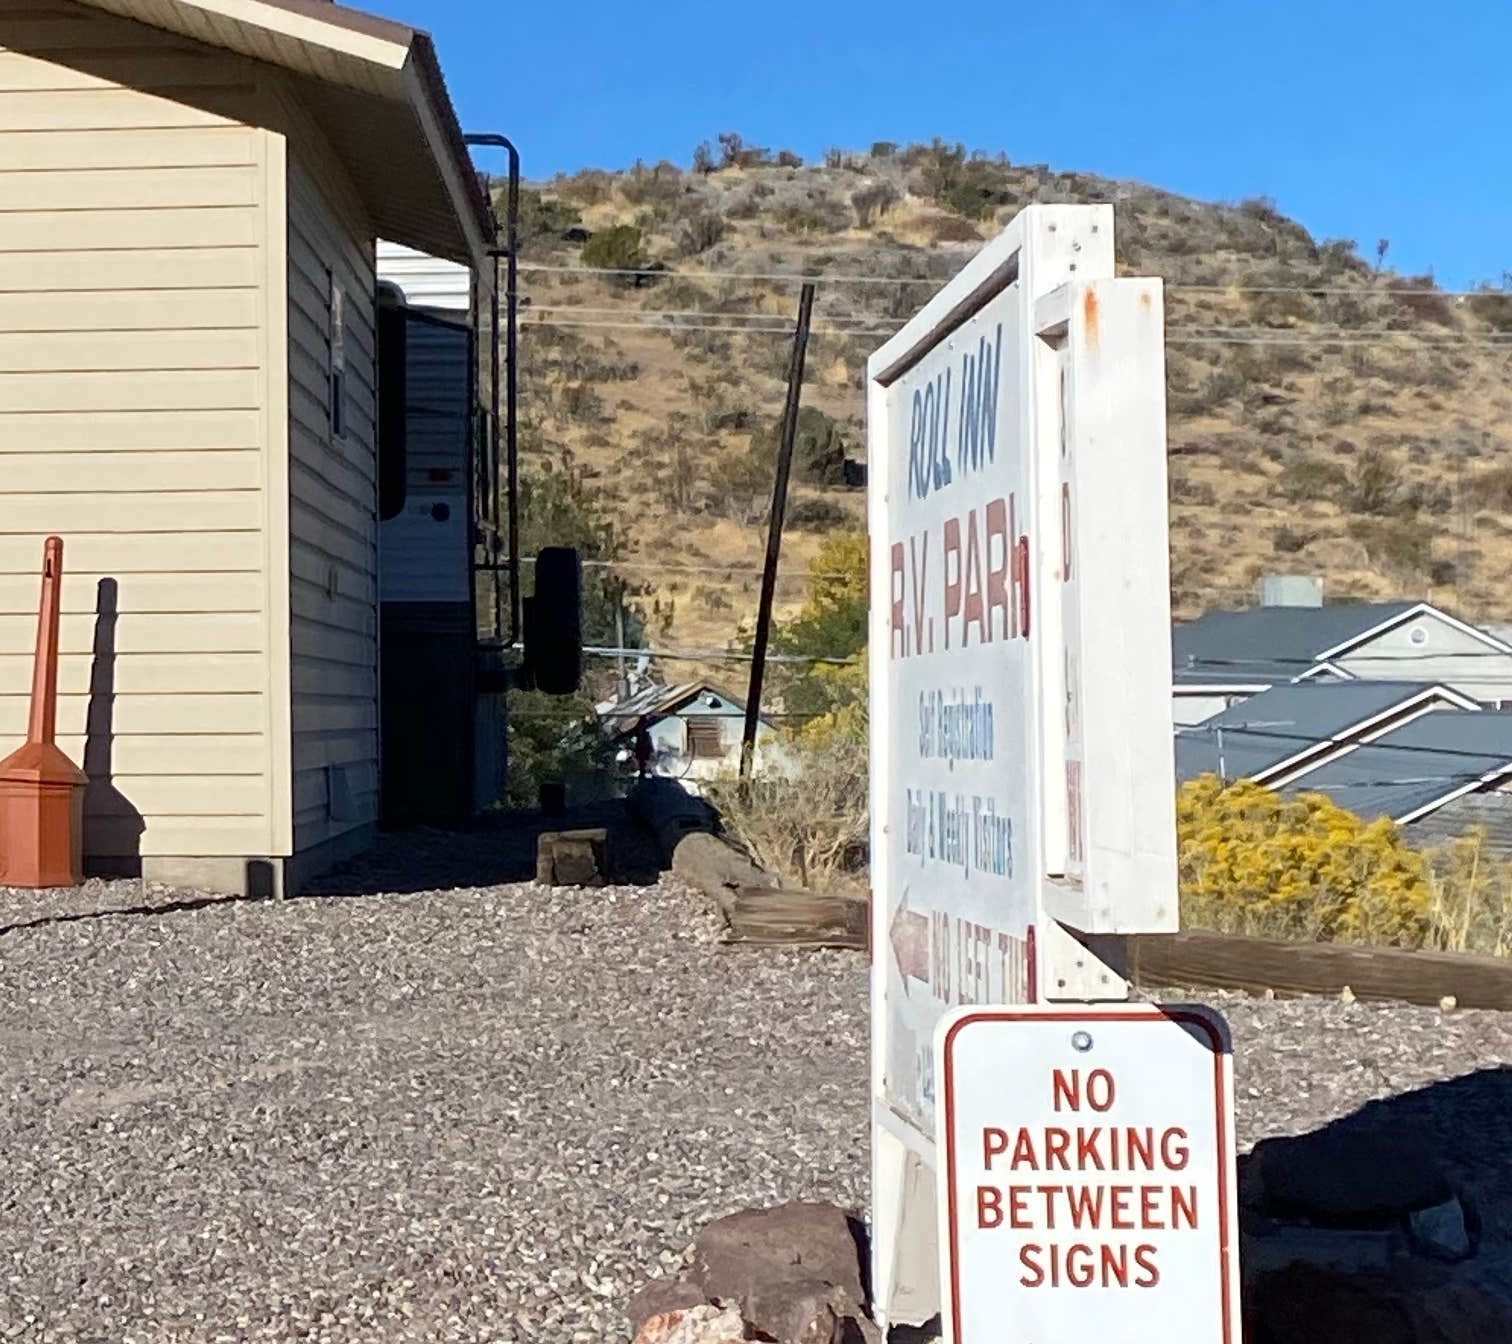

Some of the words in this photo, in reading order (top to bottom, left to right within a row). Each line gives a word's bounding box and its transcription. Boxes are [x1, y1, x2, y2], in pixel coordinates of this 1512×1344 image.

[908, 366, 952, 502] ROLL
[958, 323, 1003, 476] INN
[1052, 1068, 1117, 1113] NO
[982, 1126, 1190, 1171] PARKING
[976, 1184, 1199, 1231] BETWEEN
[1018, 1243, 1161, 1289] SIGNS
